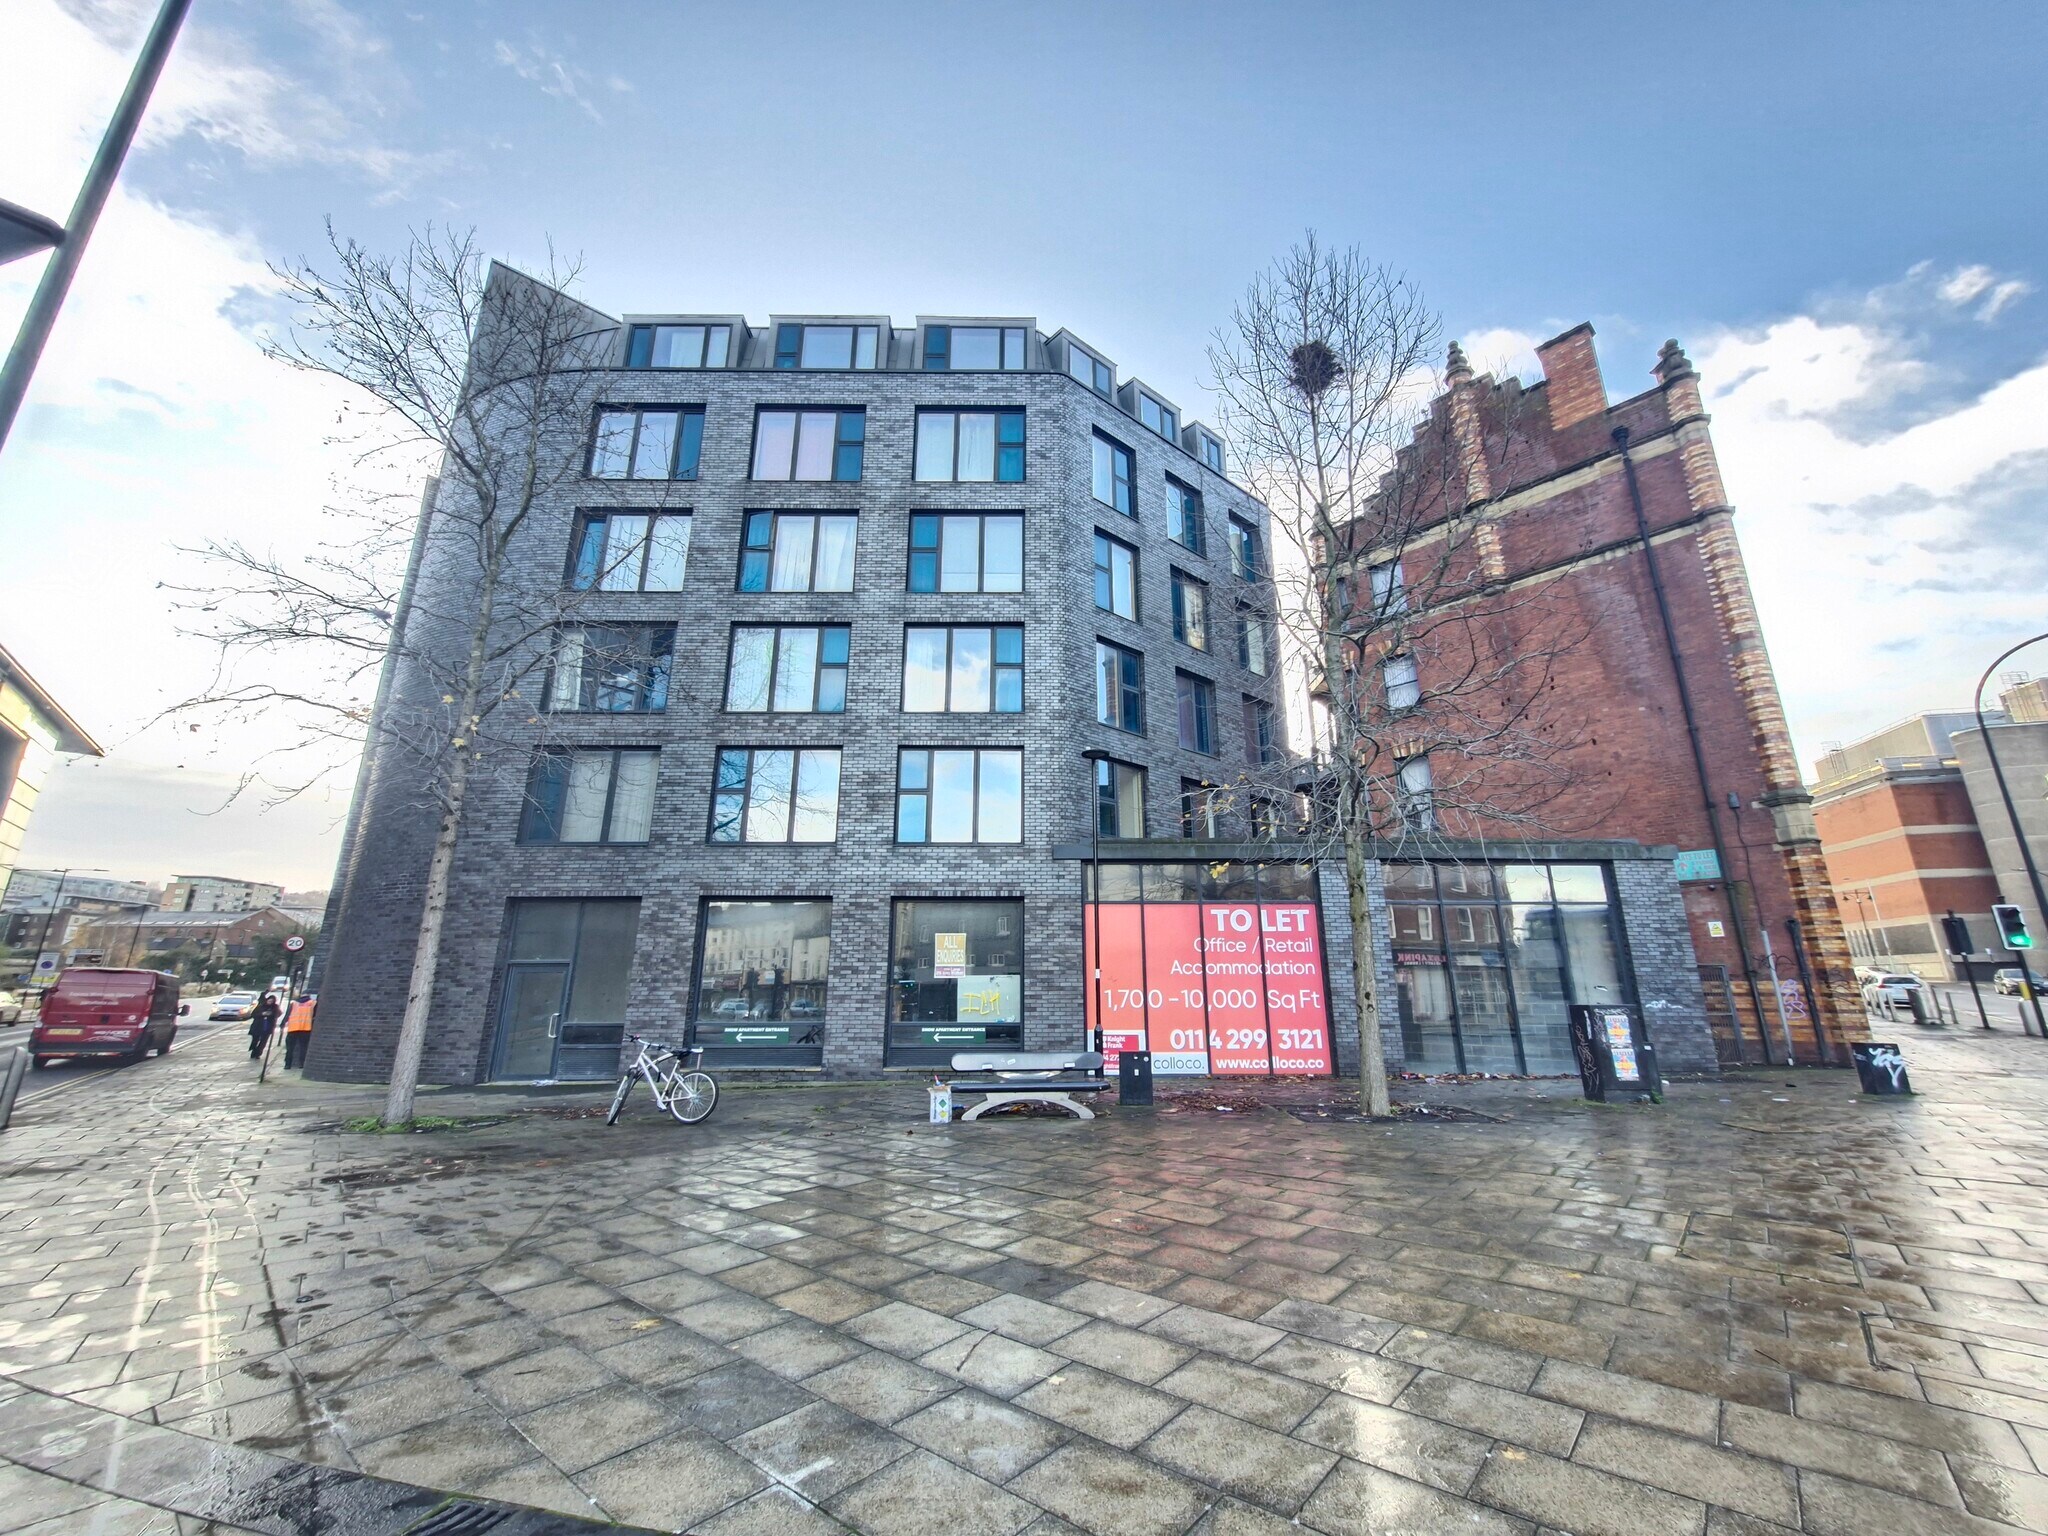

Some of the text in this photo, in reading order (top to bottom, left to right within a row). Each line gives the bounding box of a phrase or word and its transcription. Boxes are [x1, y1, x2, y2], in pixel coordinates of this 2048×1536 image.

[1211, 909, 1309, 931] TO LET
[943, 936, 958, 949] ALL
[1193, 936, 1313, 954] Office / Retail
[1170, 959, 1315, 975] Accommodation
[1104, 989, 1163, 1011] 1,700
[1268, 989, 1297, 1013] Sq
[1300, 989, 1320, 1009] Ft
[1169, 1028, 1323, 1050] 0114 299 3121
[1215, 1057, 1324, 1069] www.colloco.co
